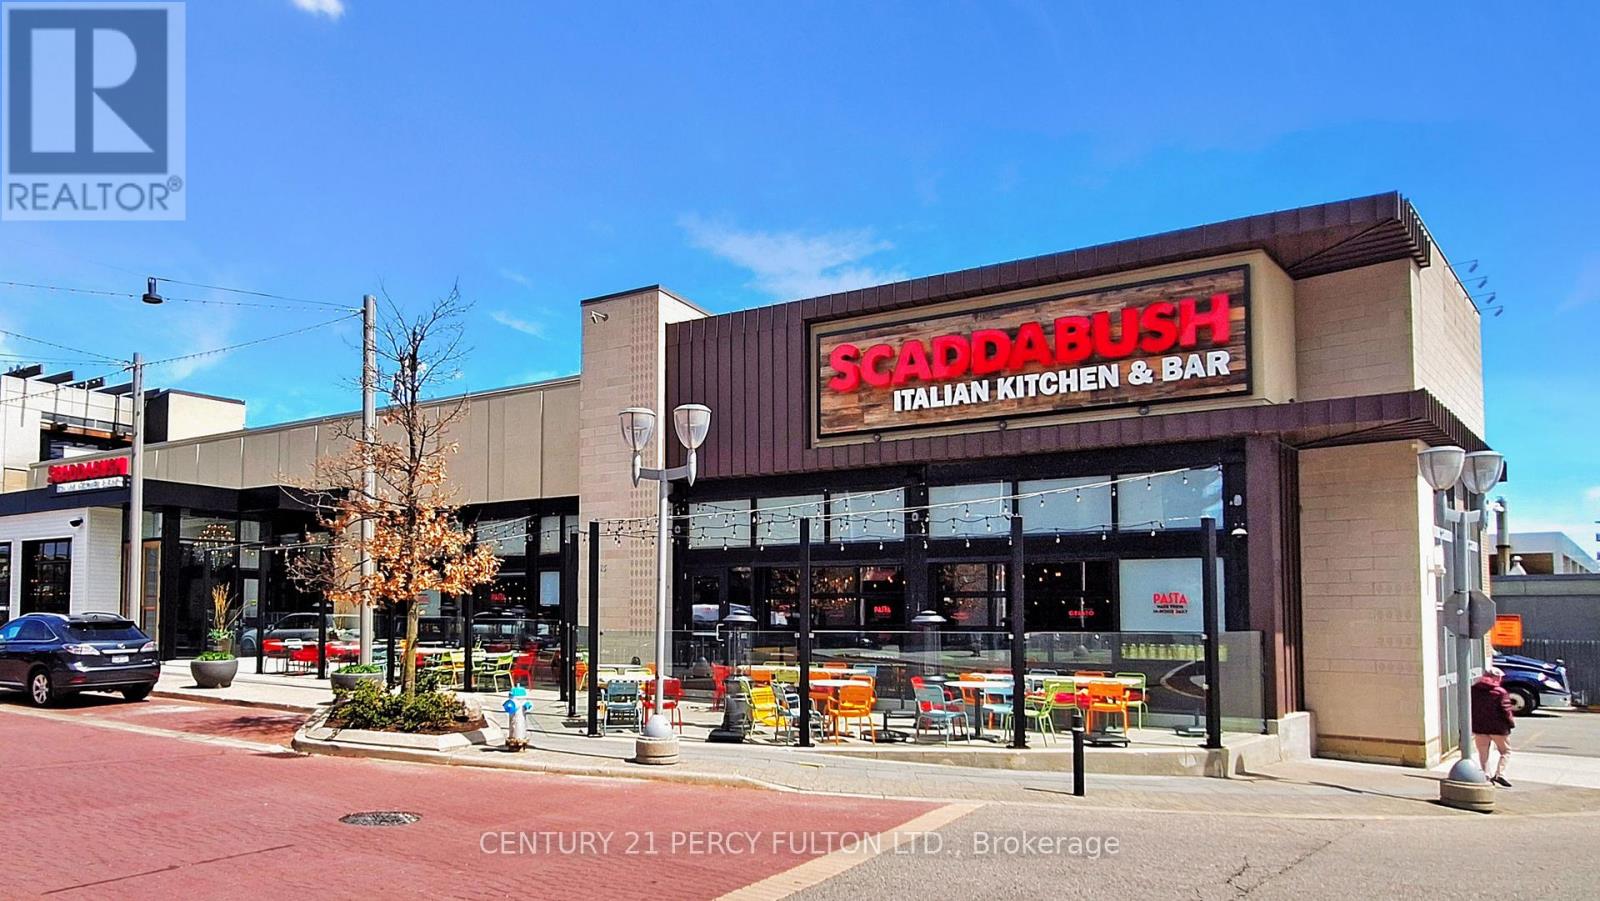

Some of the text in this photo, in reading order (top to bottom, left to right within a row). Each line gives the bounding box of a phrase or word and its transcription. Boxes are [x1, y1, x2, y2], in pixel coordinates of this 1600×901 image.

[826, 292, 1231, 393] SCADDABUSH
[893, 350, 1231, 412] ITALIAN KITCHEN & BAR
[1152, 592, 1188, 604] PASTA
